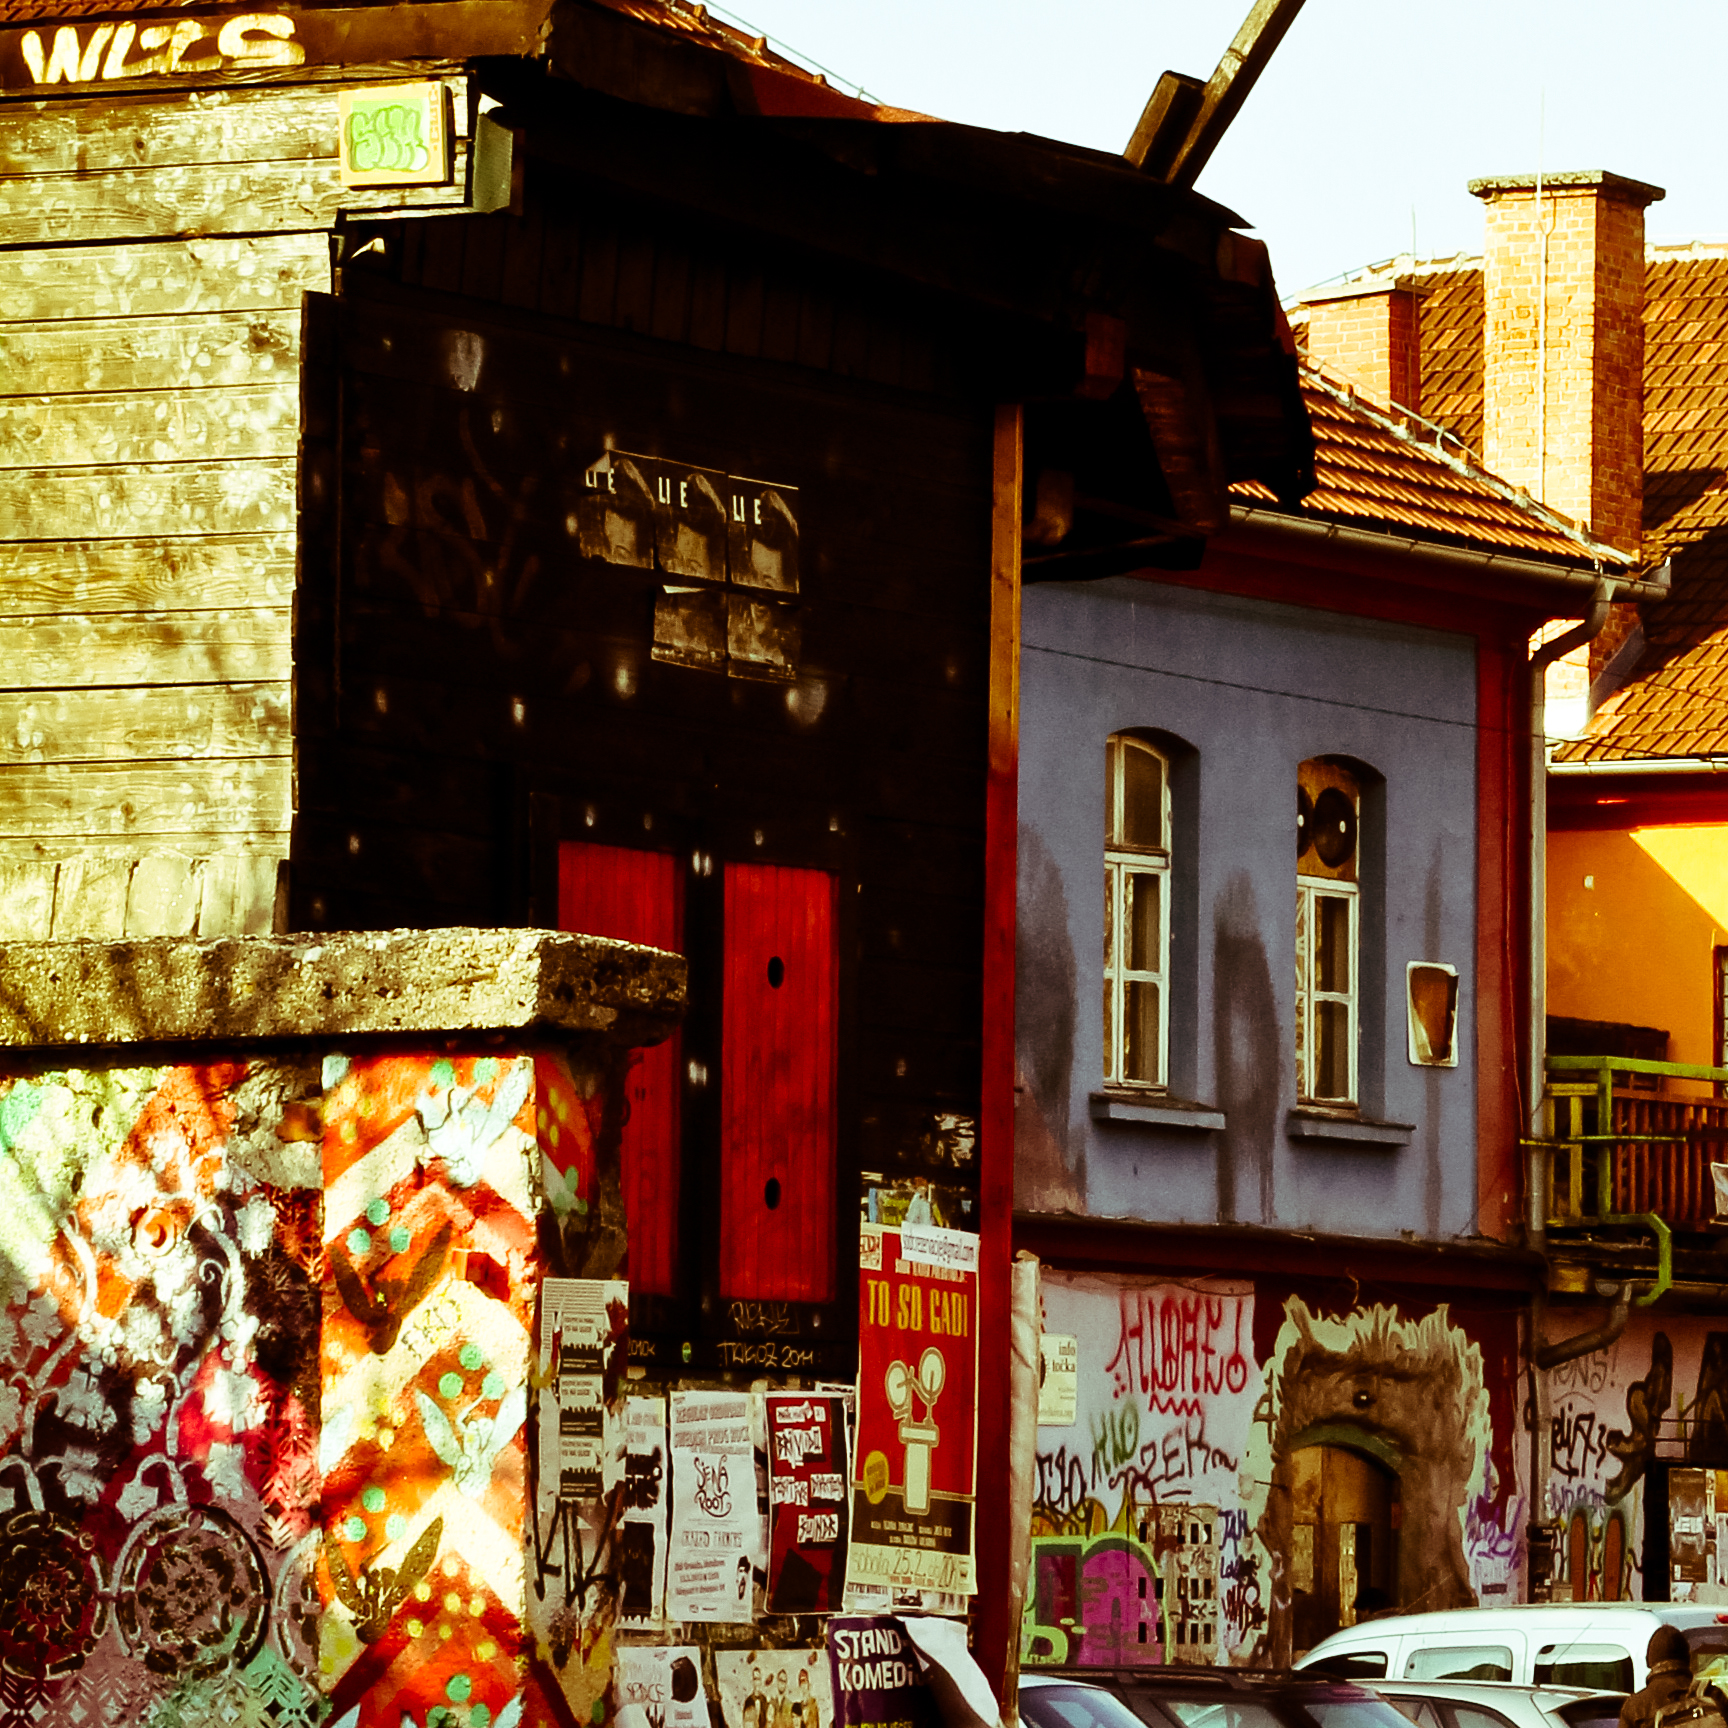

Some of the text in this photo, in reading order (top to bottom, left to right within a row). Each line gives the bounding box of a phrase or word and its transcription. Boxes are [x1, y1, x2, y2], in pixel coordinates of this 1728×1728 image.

[867, 1279, 968, 1337] TO SO GADI
[1059, 1341, 1076, 1356] info
